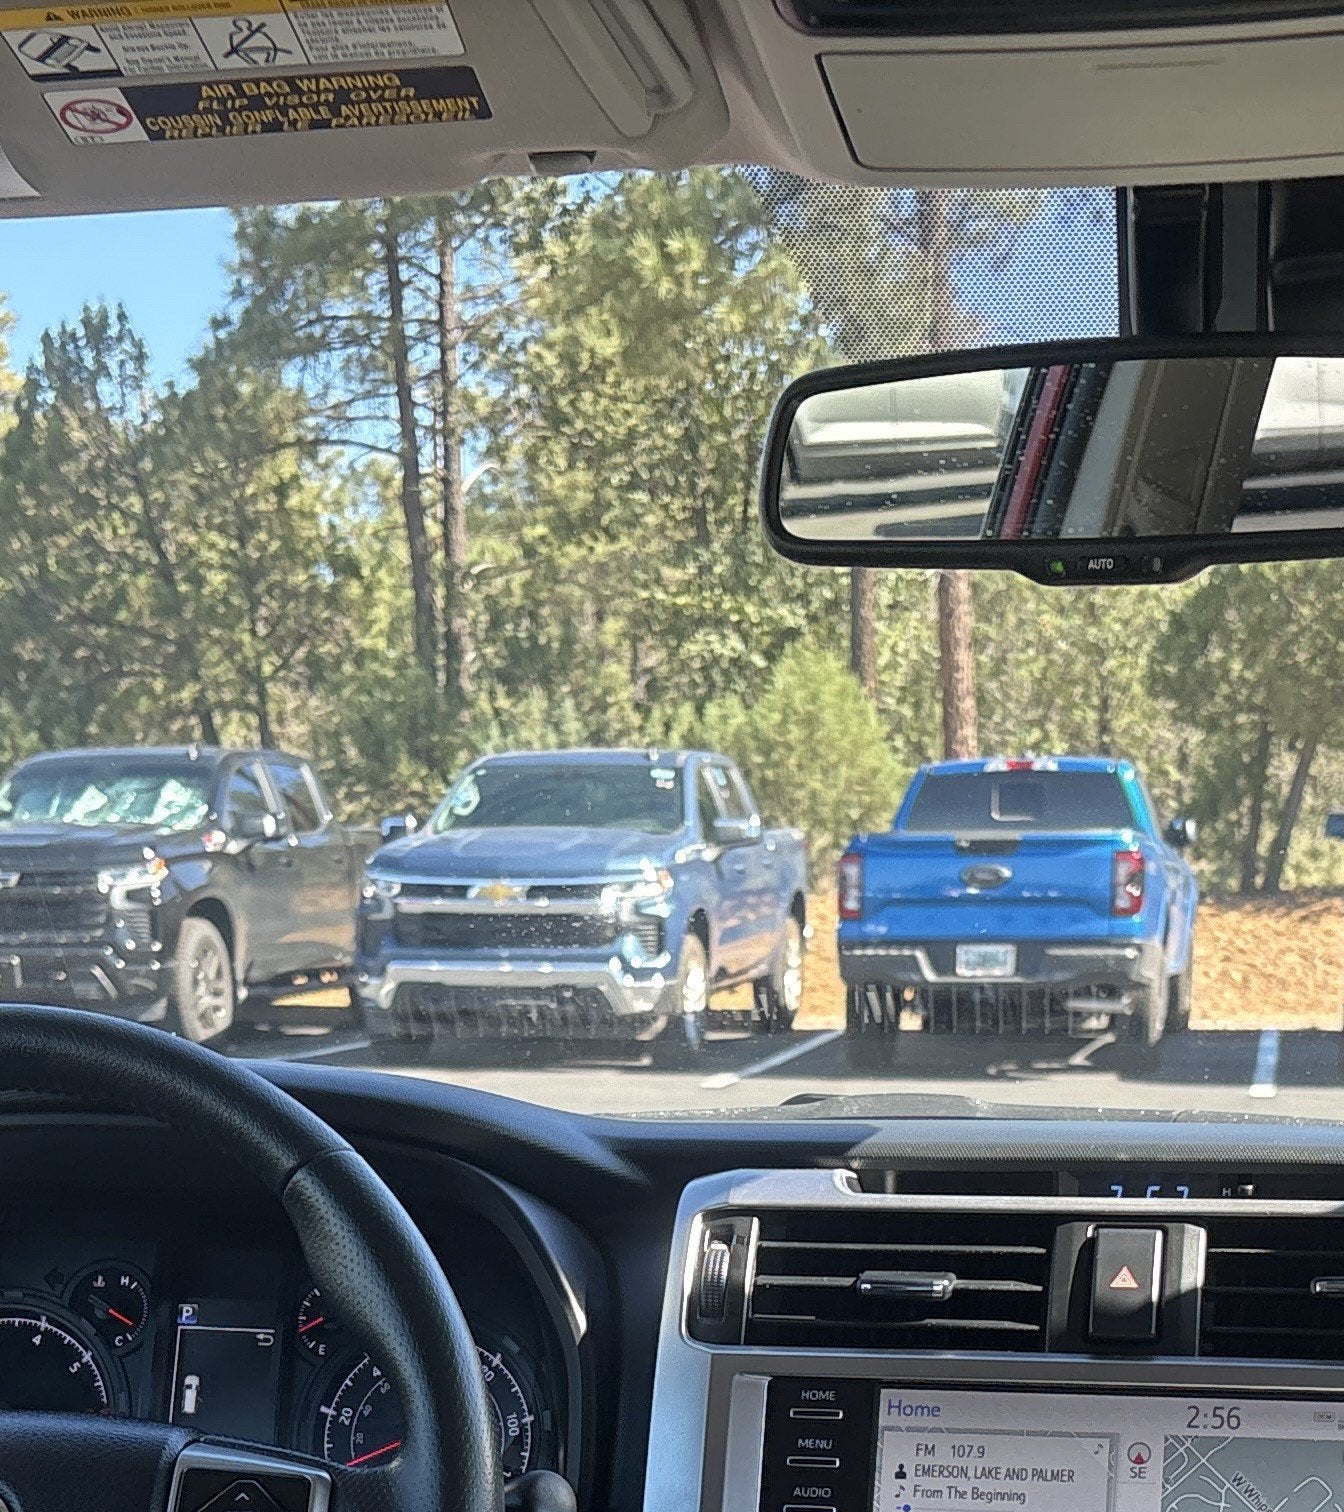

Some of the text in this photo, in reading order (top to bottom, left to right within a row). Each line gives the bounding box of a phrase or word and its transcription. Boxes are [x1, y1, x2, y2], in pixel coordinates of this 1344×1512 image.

[200, 73, 400, 98] AIR BAG WARNING
[197, 87, 415, 110] FLIP VISOR OVER
[1087, 559, 1114, 570] AUTO
[120, 1275, 130, 1286] H
[182, 1306, 193, 1321] P
[114, 1335, 125, 1347] C
[31, 1334, 42, 1347] 4
[68, 1361, 81, 1374] 5
[318, 1343, 327, 1356] E
[801, 1389, 836, 1401] HOME
[338, 1407, 354, 1425] 20
[887, 1399, 941, 1418] Home
[505, 1413, 520, 1437] 100
[1186, 1405, 1241, 1430] 2:56
[797, 1437, 833, 1450] MENU
[915, 1443, 985, 1459] FM 107.9
[914, 1464, 1075, 1483] EMERSON, LAKE AND PALMER
[1129, 1466, 1147, 1479] SE
[1231, 1472, 1244, 1484] W
[793, 1486, 832, 1499] AUDIO
[912, 1484, 1026, 1504] From The Beginning
